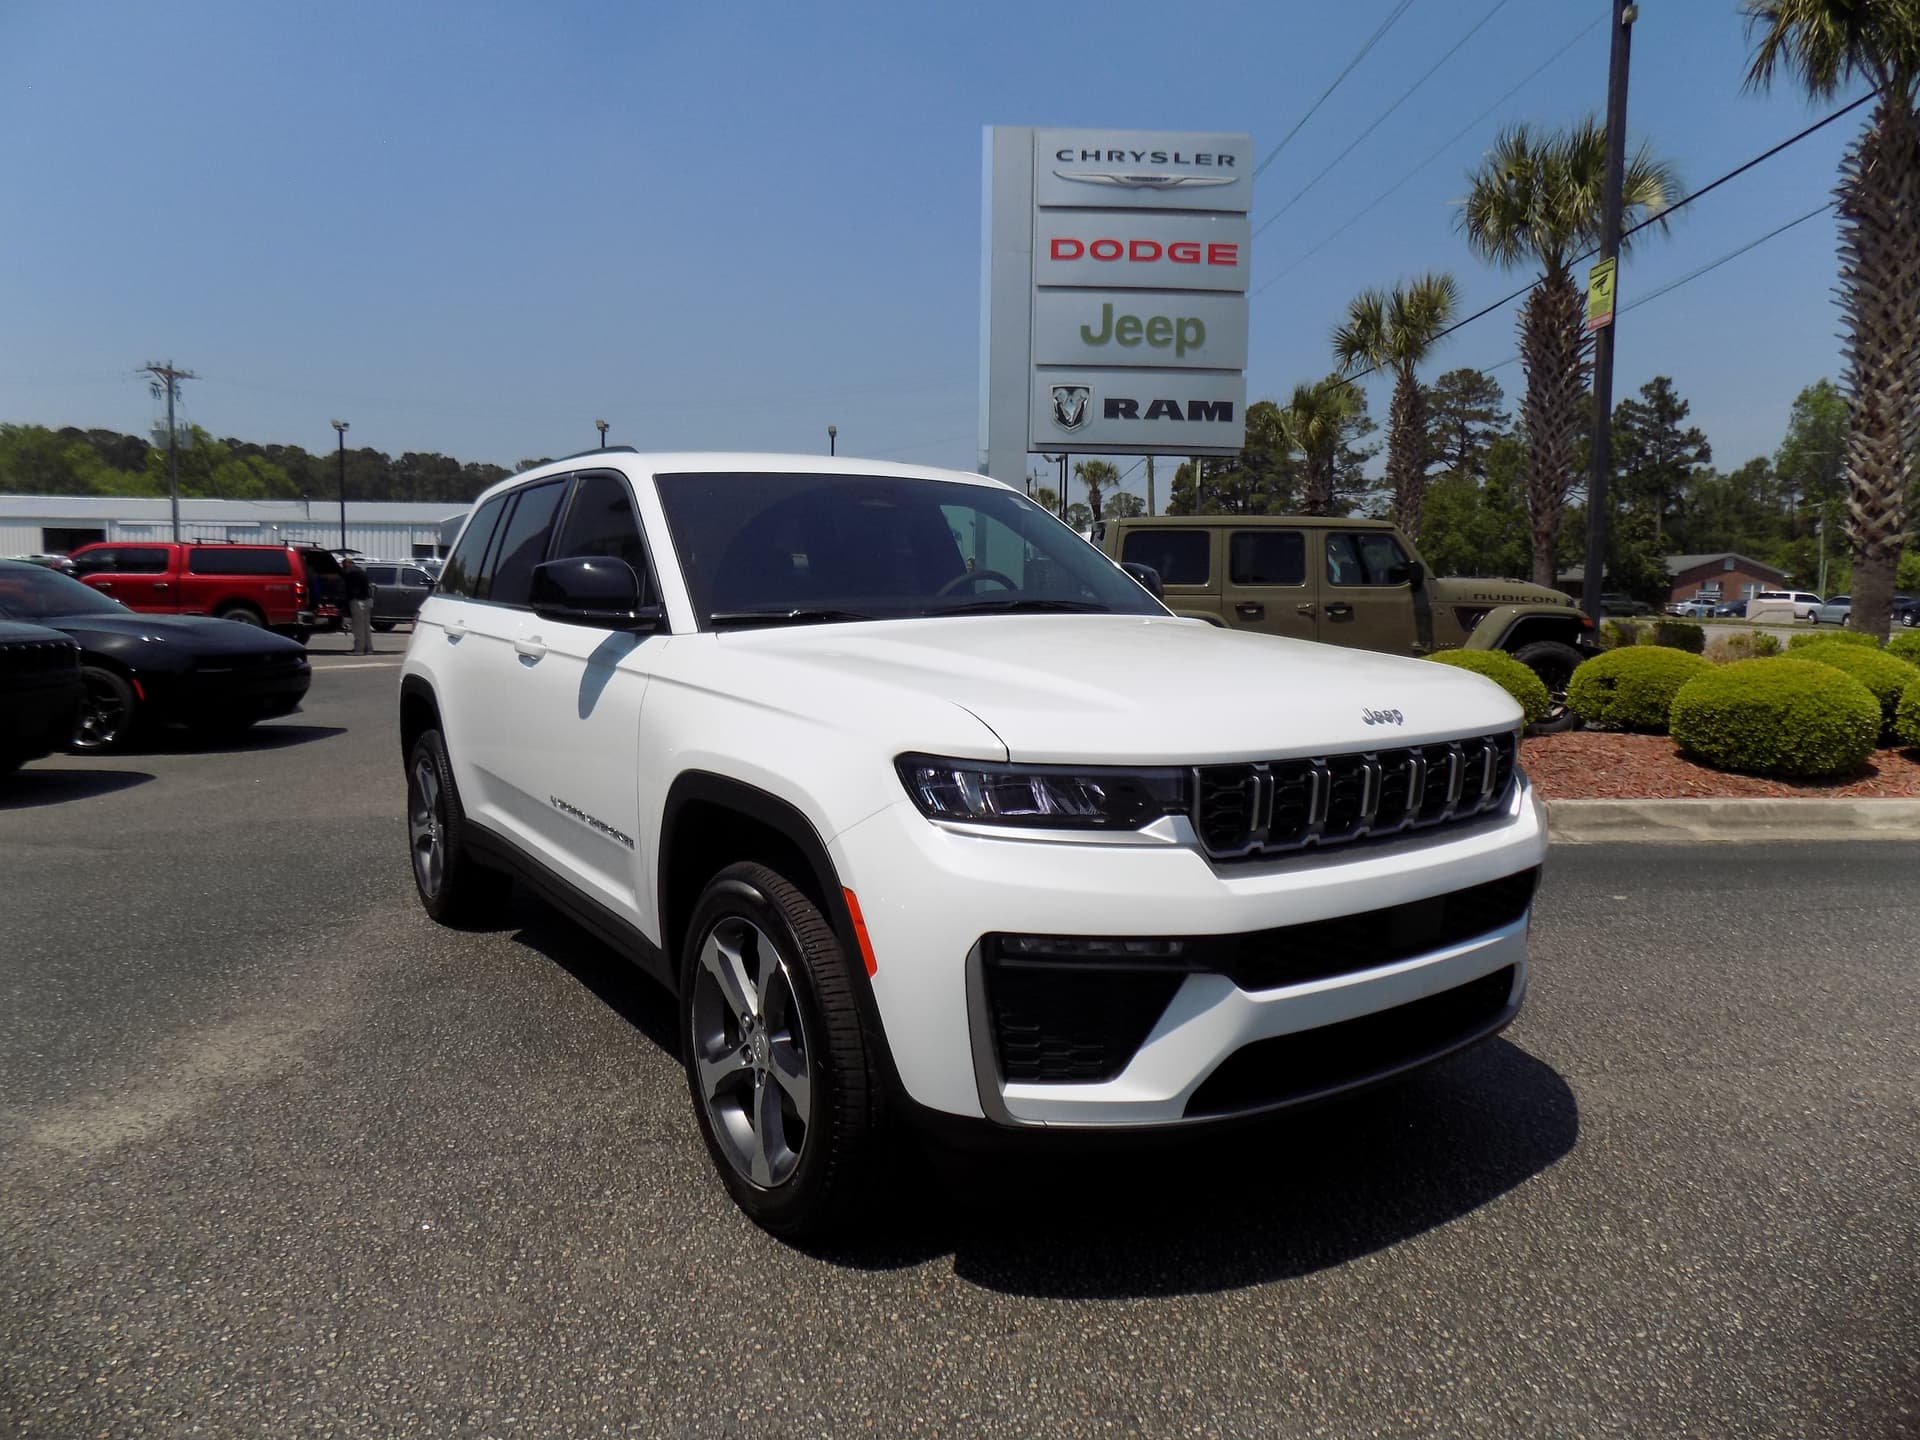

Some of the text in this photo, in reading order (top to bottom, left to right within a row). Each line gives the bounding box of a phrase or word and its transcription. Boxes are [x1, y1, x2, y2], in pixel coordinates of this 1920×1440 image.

[1056, 149, 1236, 167] CHRYSLER
[1051, 238, 1239, 266] DODGE
[1080, 303, 1206, 358] Jeep
[1104, 398, 1234, 422] RAM
[1473, 593, 1557, 604] RUBICON
[1361, 707, 1404, 727] Jeep
